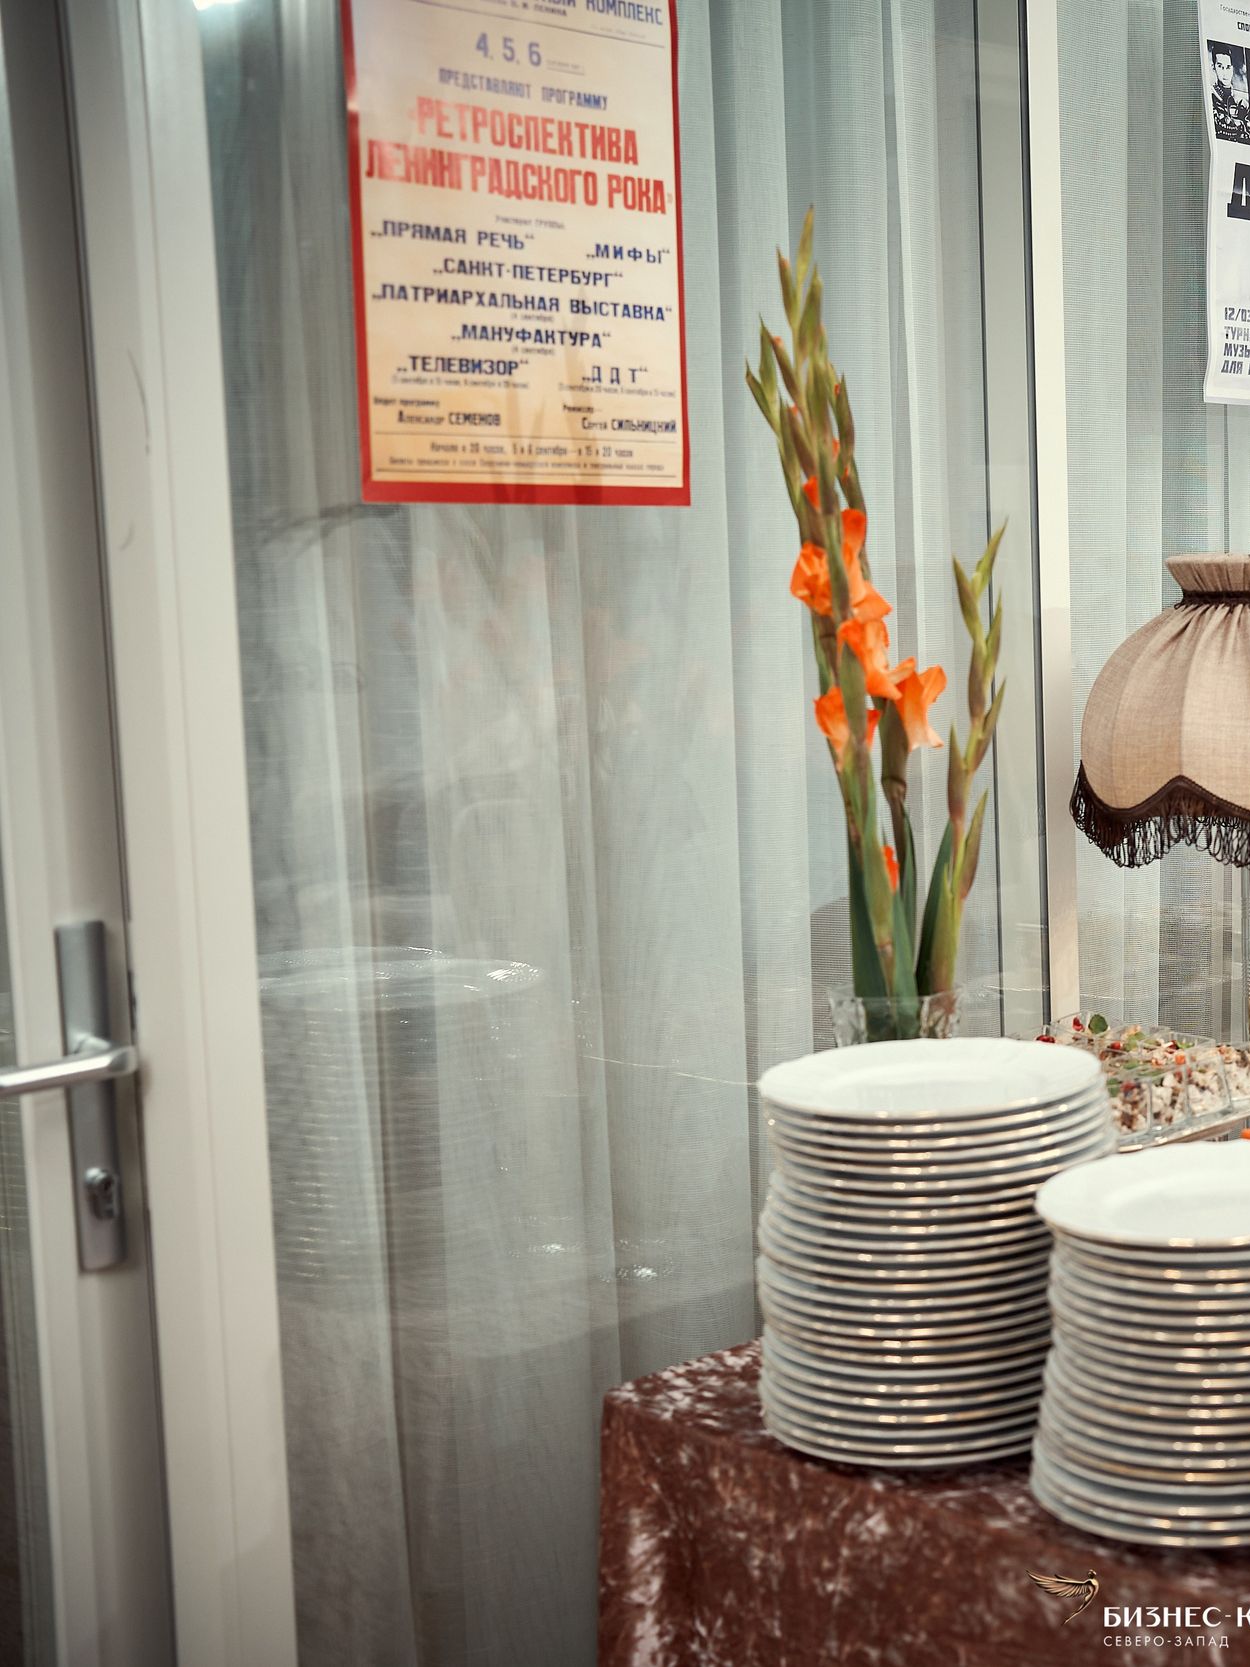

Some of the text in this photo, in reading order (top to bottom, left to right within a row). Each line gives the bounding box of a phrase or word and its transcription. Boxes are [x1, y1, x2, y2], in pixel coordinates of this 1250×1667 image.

[586, 0, 664, 25] КОМПЛЕКС
[528, 42, 541, 67] 6
[438, 67, 609, 111] ПРЕДСТАВЛЯЮТ ПРОГРАММУ
[365, 139, 599, 206] ЛЕНИНГРАДСКОГО
[1221, 359, 1244, 375] ДЛЯ
[448, 411, 502, 427] СЕМЕНОВ
